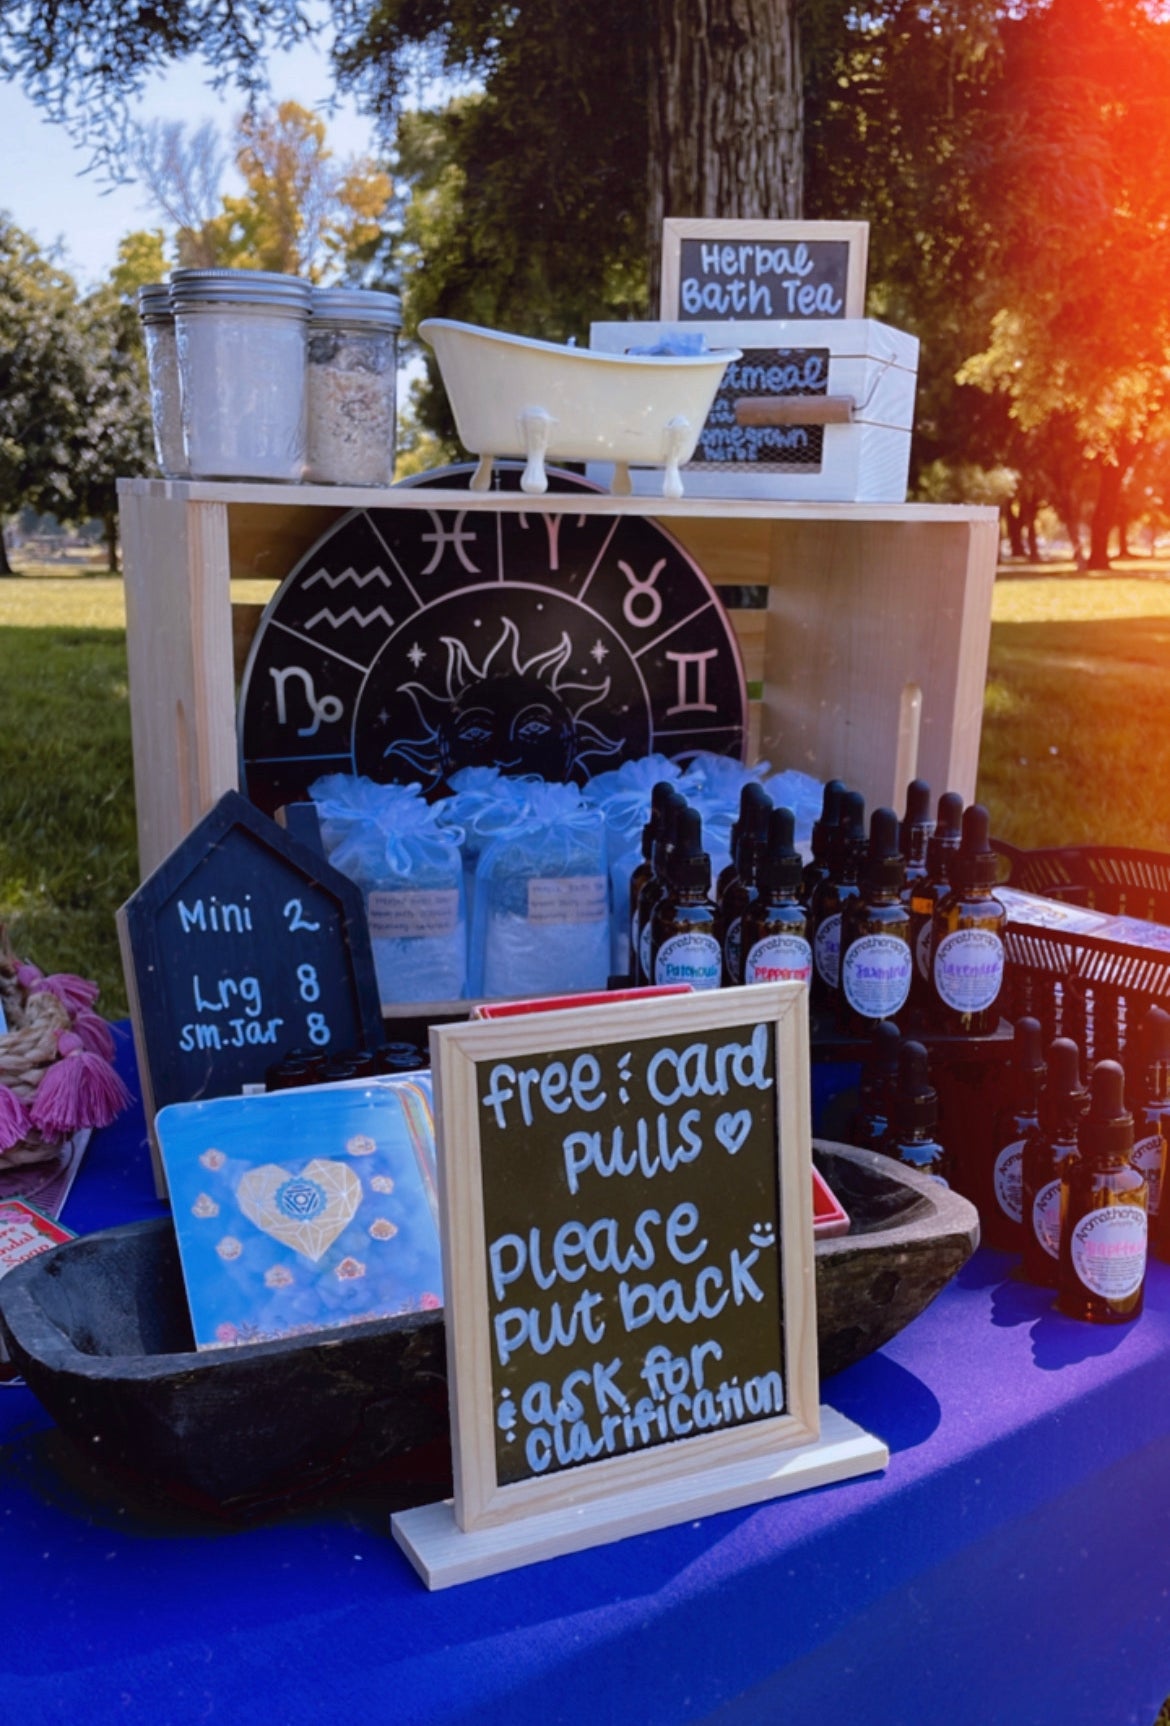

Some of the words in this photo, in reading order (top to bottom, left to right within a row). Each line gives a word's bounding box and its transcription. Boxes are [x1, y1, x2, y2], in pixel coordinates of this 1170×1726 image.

[701, 243, 814, 276] Herbal
[682, 278, 773, 315] Bath
[782, 280, 843, 315] Tea
[720, 356, 828, 391] tmeal
[699, 426, 807, 448] omegrown
[177, 894, 252, 933] Mini
[284, 899, 320, 932] 2
[193, 975, 262, 1017] Lrg
[297, 964, 320, 1002] 8
[307, 1013, 330, 1045] 8
[483, 1064, 606, 1129] free
[647, 1023, 773, 1106] card
[562, 1109, 702, 1195] pulls
[490, 1202, 707, 1301] please
[494, 1289, 605, 1366] put
[618, 1248, 764, 1333] back
[522, 1357, 628, 1426] ask
[641, 1339, 722, 1400] for
[526, 1376, 784, 1472] clarification
